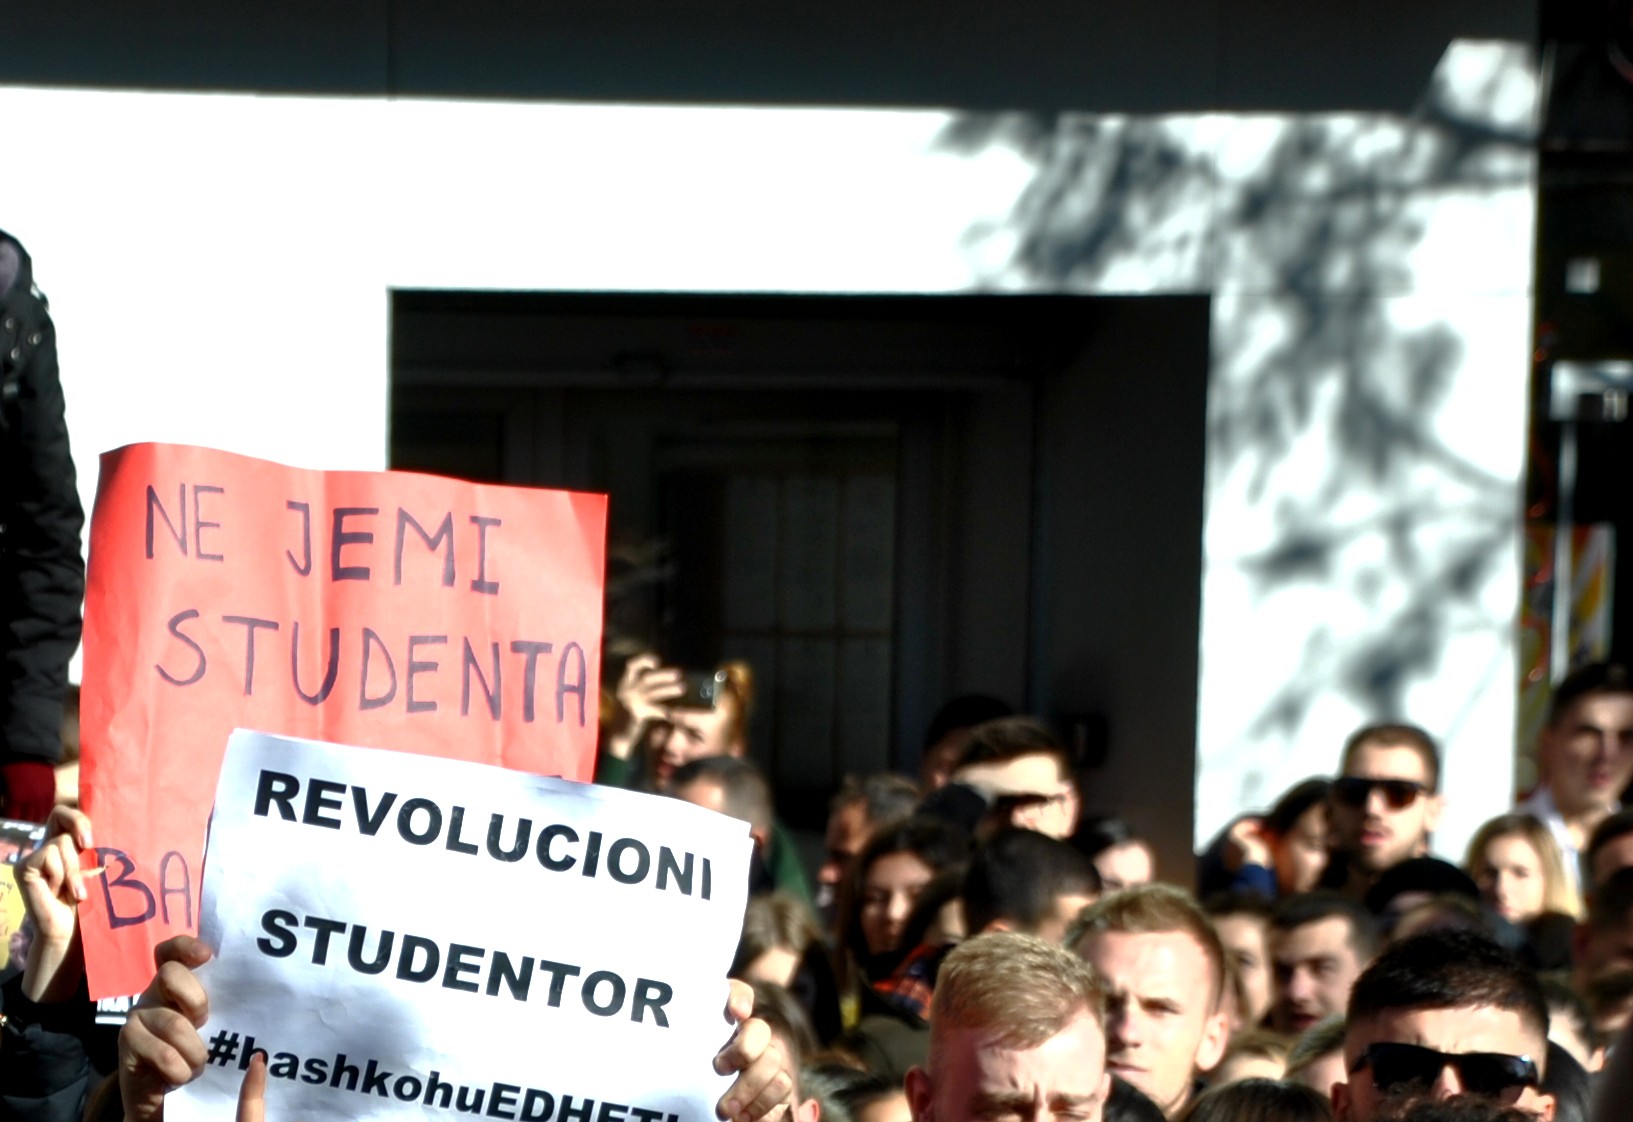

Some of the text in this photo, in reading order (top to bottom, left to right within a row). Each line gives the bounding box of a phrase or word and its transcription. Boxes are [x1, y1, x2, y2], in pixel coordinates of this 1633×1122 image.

[145, 484, 503, 595] NE JEMI
[156, 608, 588, 728] STUDENTA
[254, 769, 713, 902] REVOLUCIONI
[256, 908, 675, 1029] STUDENTOR
